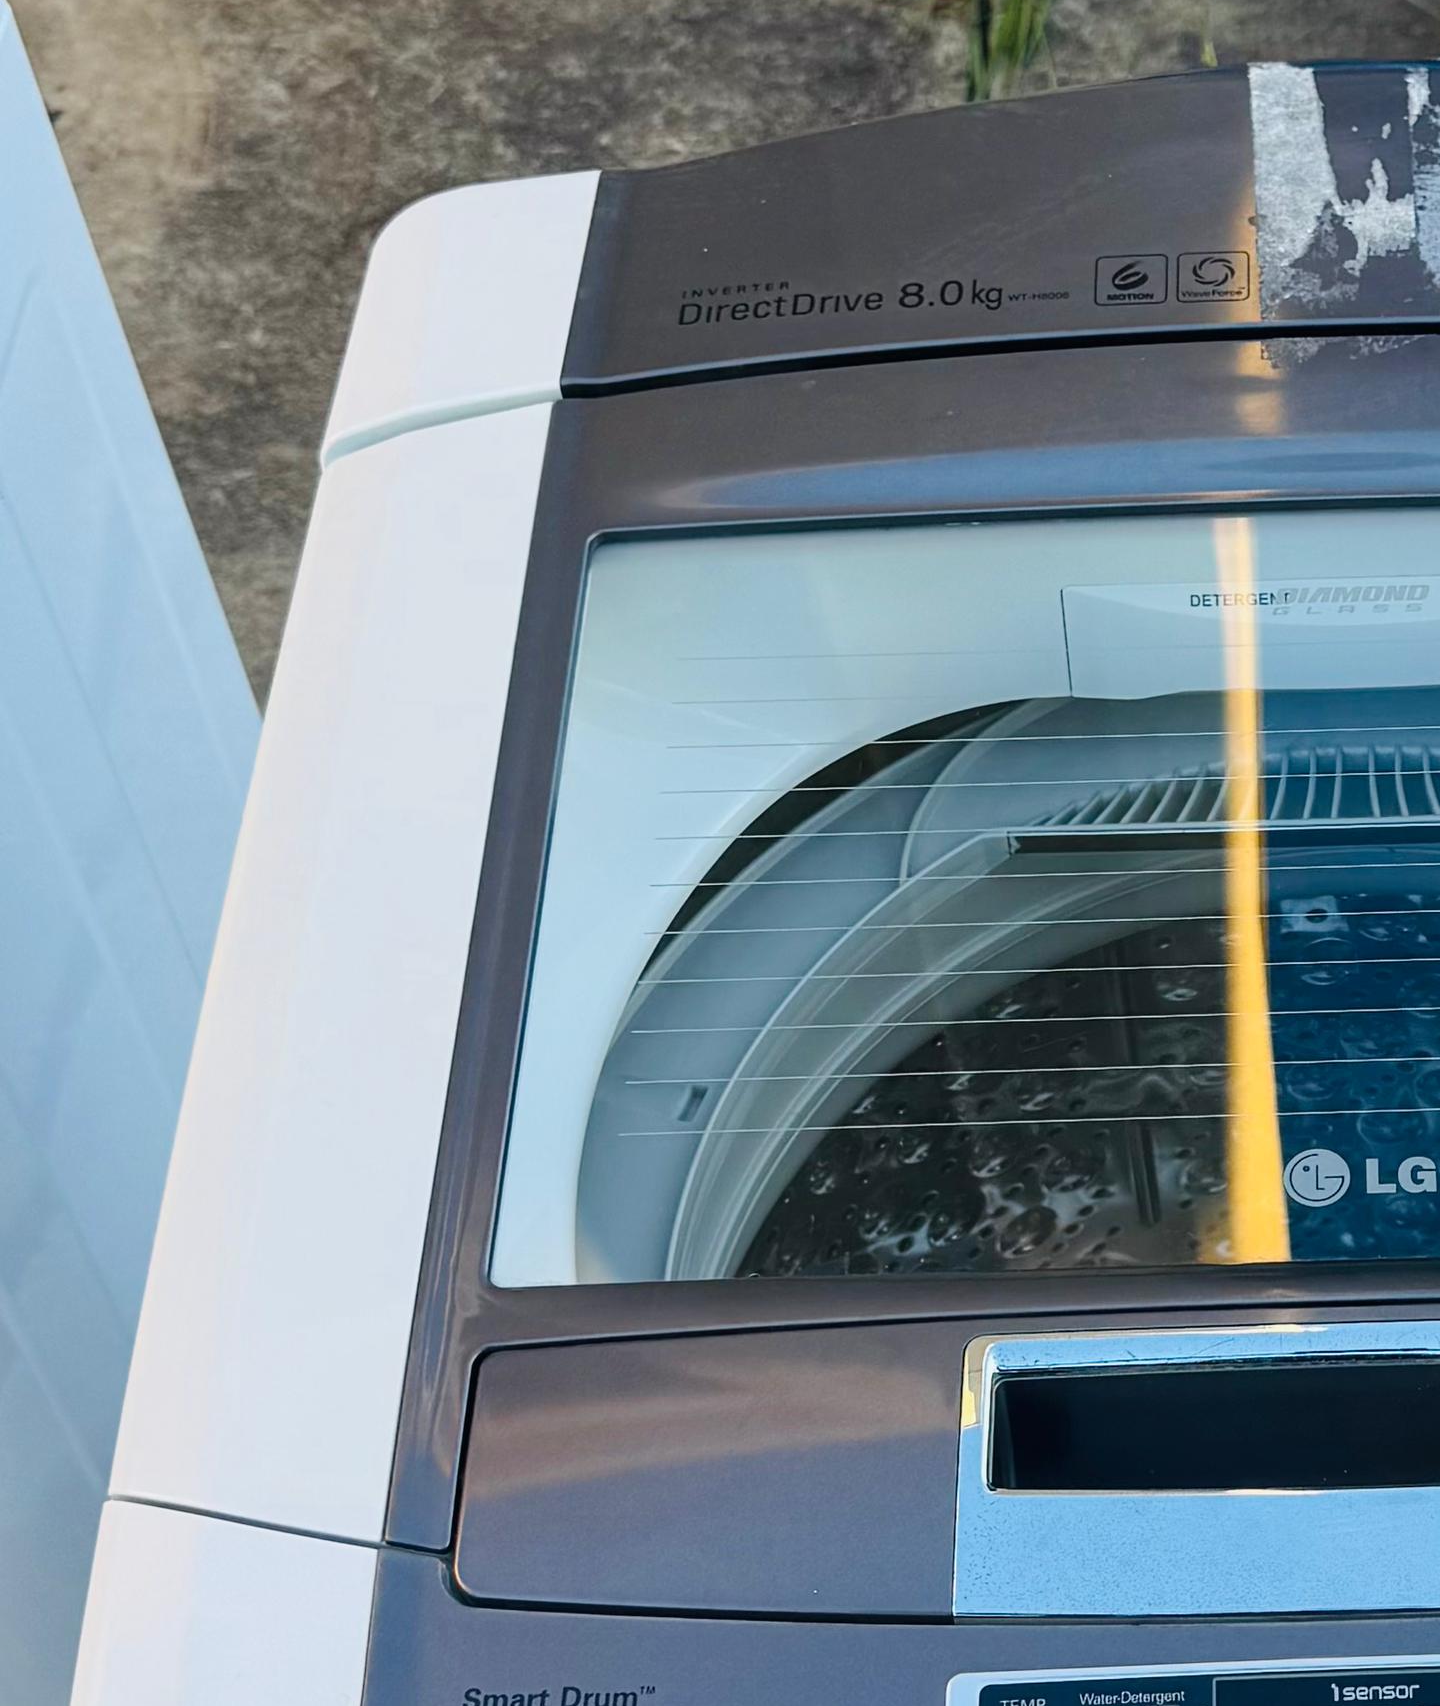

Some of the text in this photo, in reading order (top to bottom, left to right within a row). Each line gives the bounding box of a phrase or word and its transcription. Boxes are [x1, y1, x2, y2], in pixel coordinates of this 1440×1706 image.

[681, 281, 790, 299] INVERTER
[1106, 293, 1154, 302] MOTION
[1190, 592, 1291, 607] DETERGENT
[1276, 584, 1430, 605] DIAMOND
[1272, 602, 1423, 616] GLASS
[1365, 1156, 1438, 1195] LG
